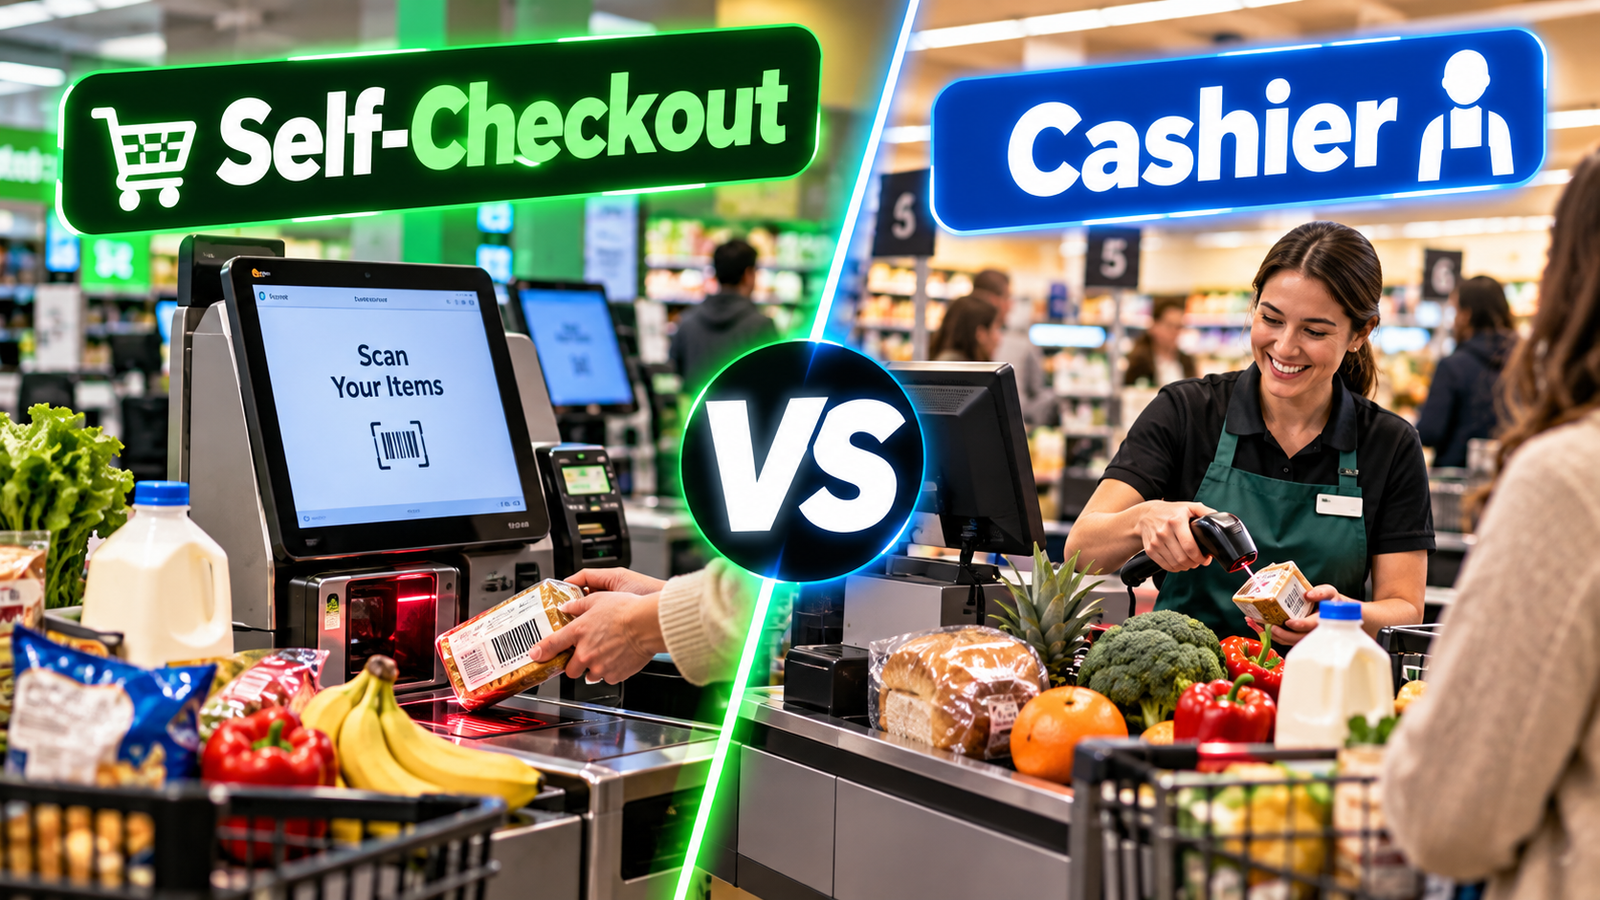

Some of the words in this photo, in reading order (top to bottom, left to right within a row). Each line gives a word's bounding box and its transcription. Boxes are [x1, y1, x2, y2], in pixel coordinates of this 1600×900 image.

[892, 191, 917, 239] 5
[1099, 238, 1127, 279] 5
[357, 343, 409, 367] Scan
[330, 376, 382, 399] Your
[387, 375, 444, 398] Items
